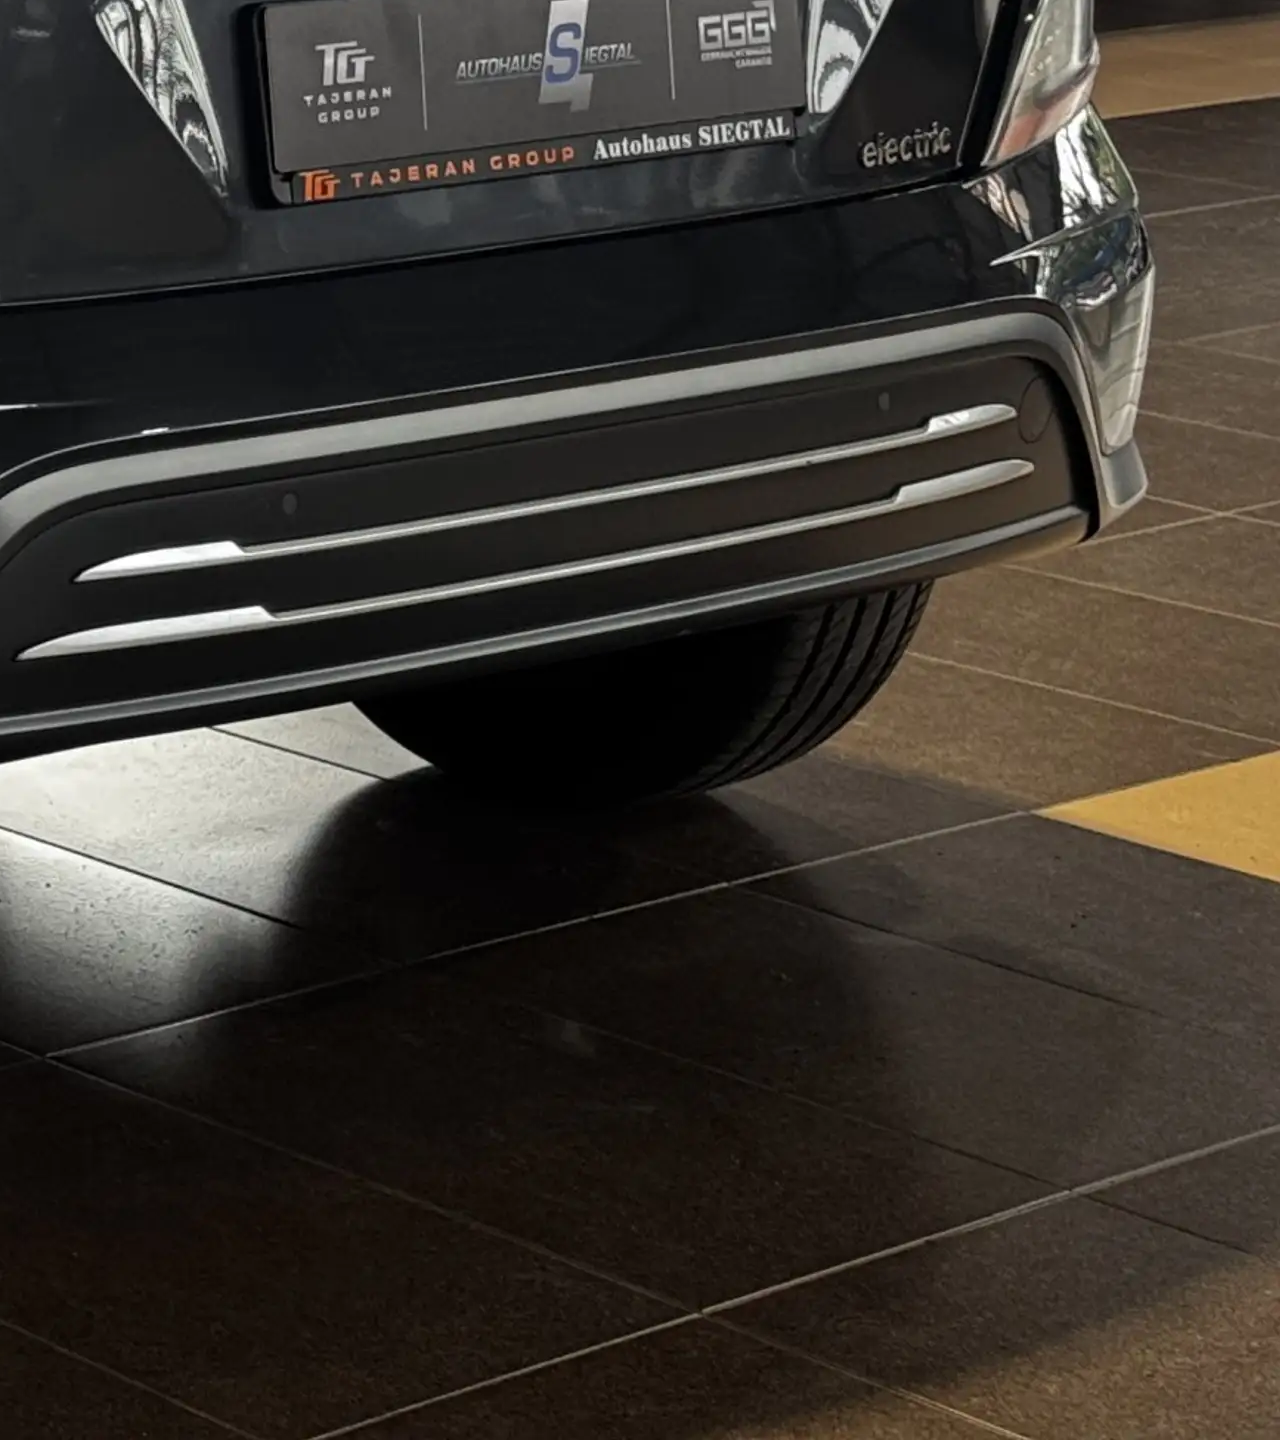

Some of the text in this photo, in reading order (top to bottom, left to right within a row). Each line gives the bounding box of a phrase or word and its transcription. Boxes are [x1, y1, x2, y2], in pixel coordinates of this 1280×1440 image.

[697, 8, 772, 51] GGG
[455, 52, 544, 80] AUTOHAUS
[303, 86, 392, 108] TAJERAN
[317, 106, 380, 125] GROUP
[592, 115, 791, 161] Autohaus SIEGTAL
[862, 120, 952, 168] electric
[350, 157, 476, 189] TAJERAN
[489, 145, 576, 172] GROUP
